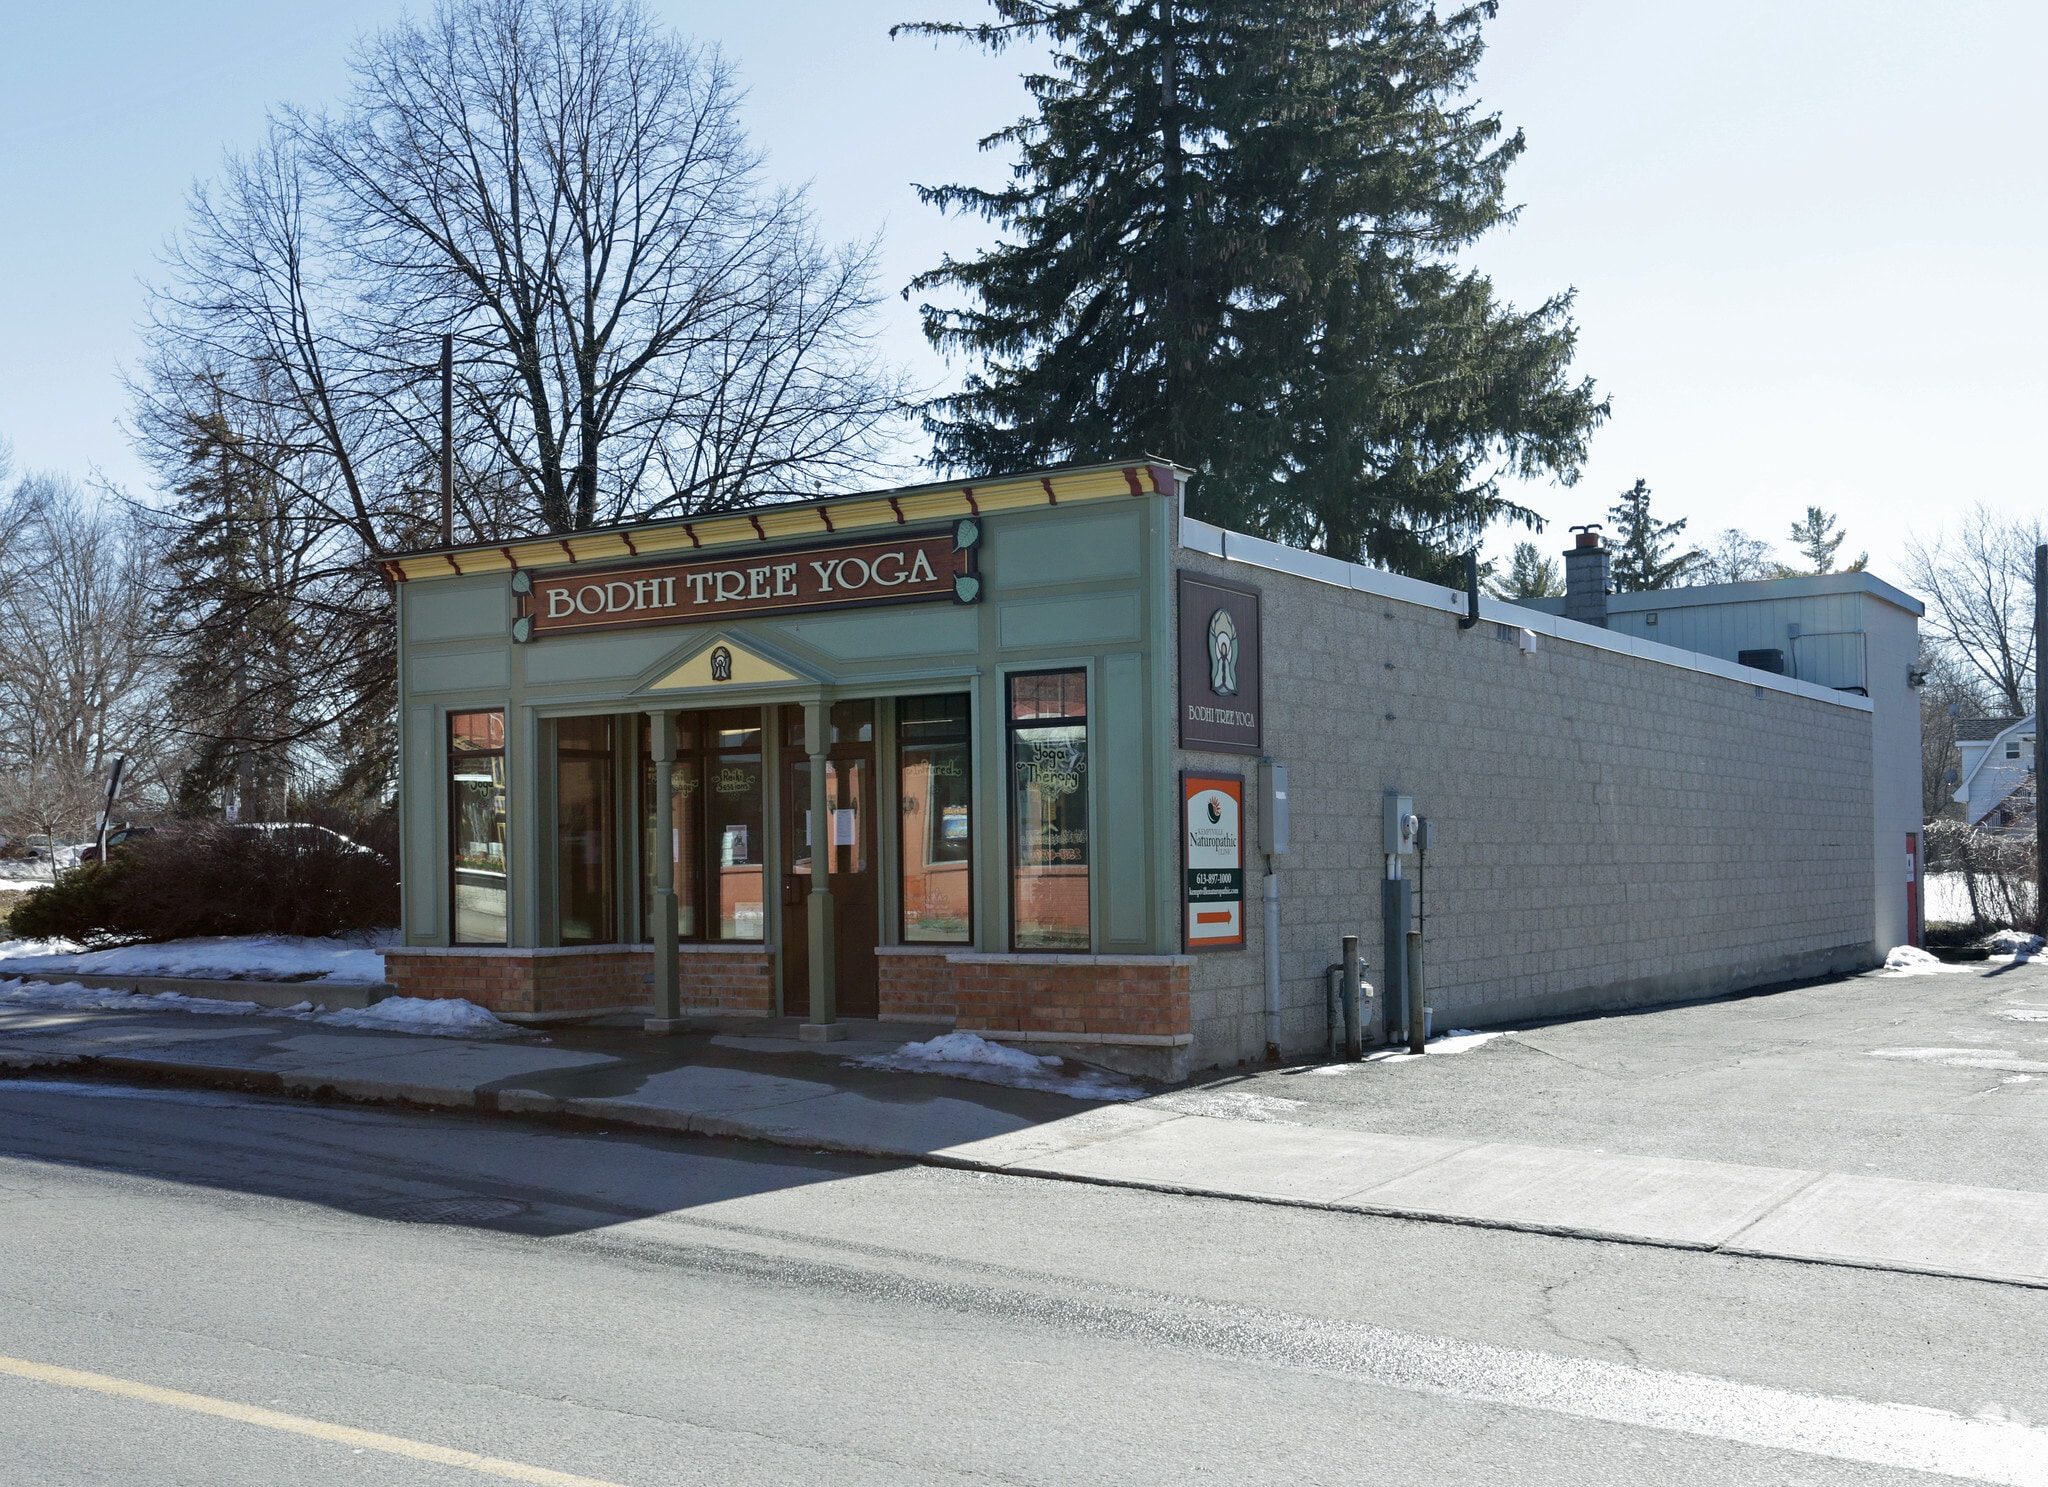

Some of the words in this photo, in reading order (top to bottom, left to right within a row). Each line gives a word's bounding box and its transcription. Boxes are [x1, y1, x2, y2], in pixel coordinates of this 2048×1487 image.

[547, 577, 677, 618] BODHI
[687, 563, 798, 604] TREE
[810, 549, 938, 592] YOGA
[1188, 705, 1214, 722] BODHI
[1215, 708, 1235, 725] TREE
[1235, 711, 1255, 727] YOGA
[1034, 742, 1065, 768] Yoga
[722, 769, 743, 782] Reiki
[1027, 763, 1078, 787] Therapy
[718, 782, 750, 791] Sessions
[1190, 832, 1236, 852] Naturopathic
[1196, 873, 1232, 884] 613-897-1000
